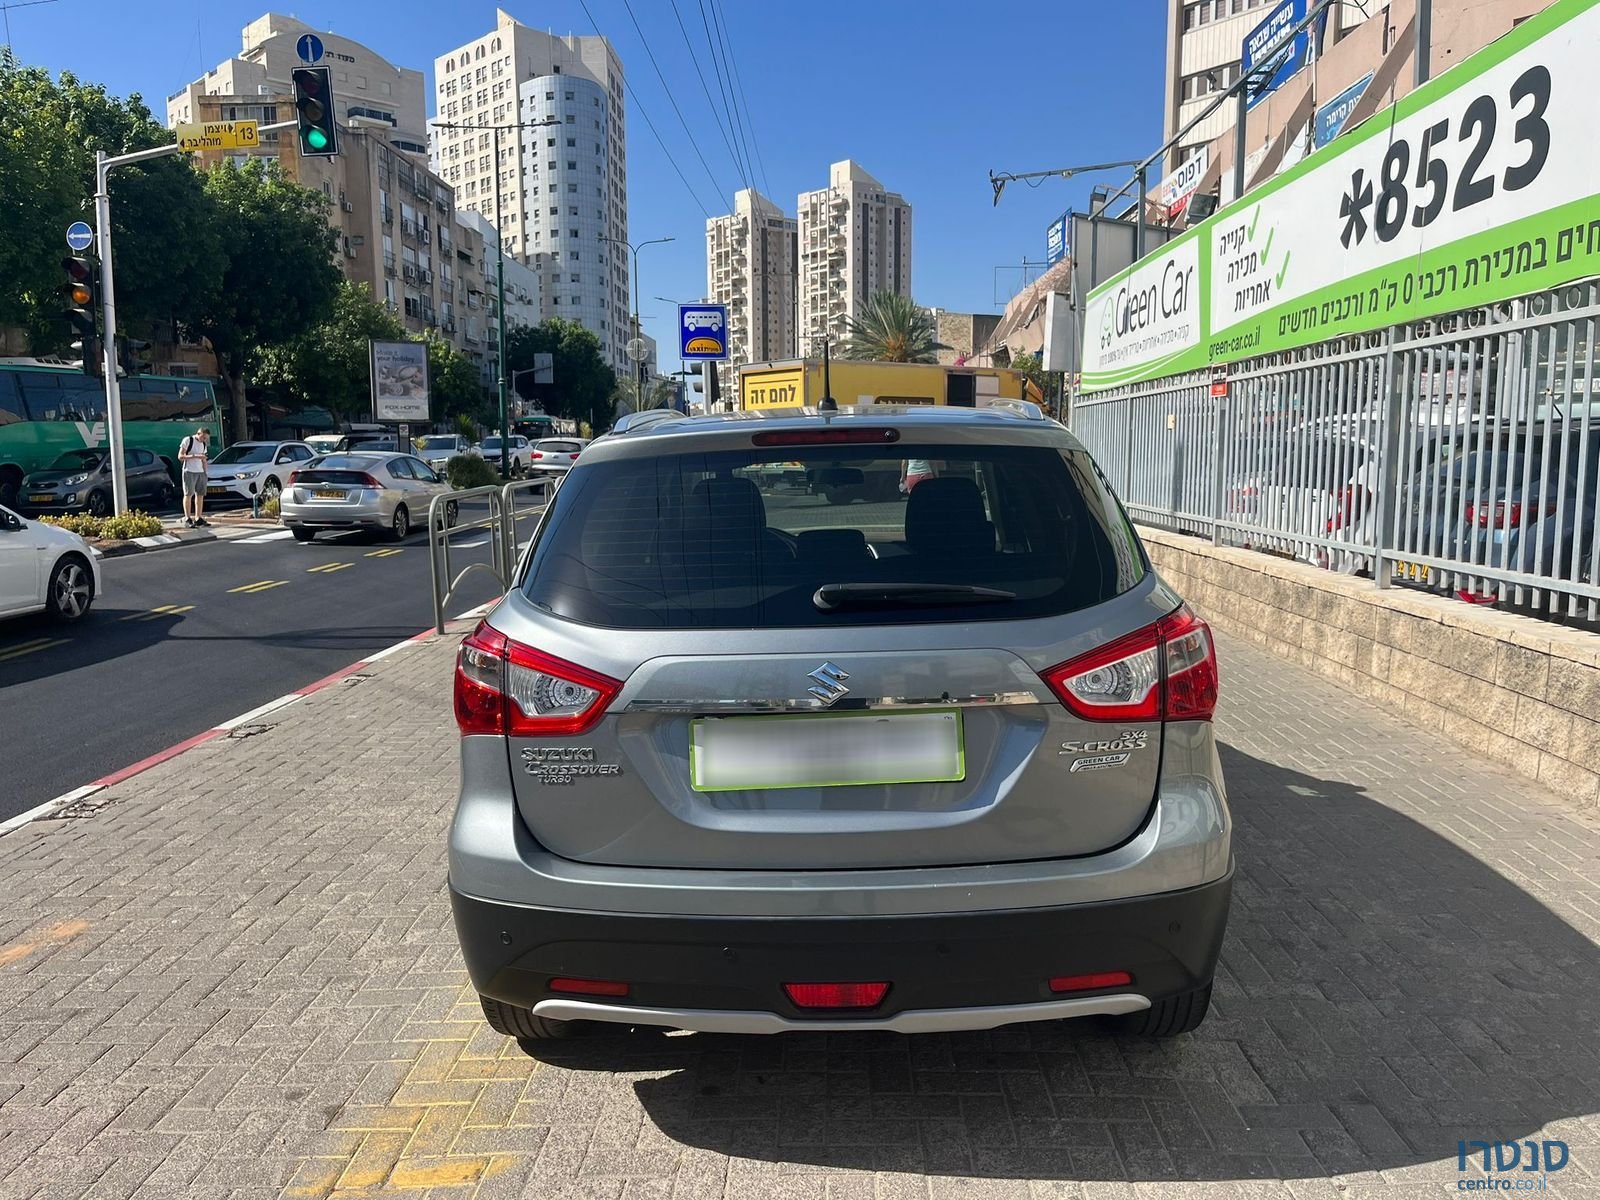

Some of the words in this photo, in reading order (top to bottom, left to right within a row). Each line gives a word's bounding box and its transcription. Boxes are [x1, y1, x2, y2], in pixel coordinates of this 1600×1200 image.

[188, 136, 222, 147] מוהליבר
[204, 125, 227, 136] ויצמן
[240, 127, 254, 140] 13
[1178, 157, 1201, 188] דפוס
[1220, 224, 1246, 256] קנייה
[1227, 252, 1257, 283] מכירה
[1463, 237, 1547, 288] במכירת
[1235, 279, 1271, 312] אחריות
[1403, 273, 1413, 304] 0
[1418, 265, 1457, 299] רכבי
[1116, 284, 1157, 338] Green
[1161, 259, 1193, 319] Car
[1321, 292, 1364, 325] ורכבים
[1279, 306, 1317, 336] חדשים
[1209, 325, 1261, 361] green-car.co.il
[751, 389, 765, 404] זה
[769, 384, 796, 404] לחם
[1120, 729, 1148, 740] SX4
[521, 747, 594, 761] SUZUKI
[524, 761, 620, 775] CROSSOVER
[1077, 757, 1104, 766] GREEN
[537, 774, 572, 784] TURBO
